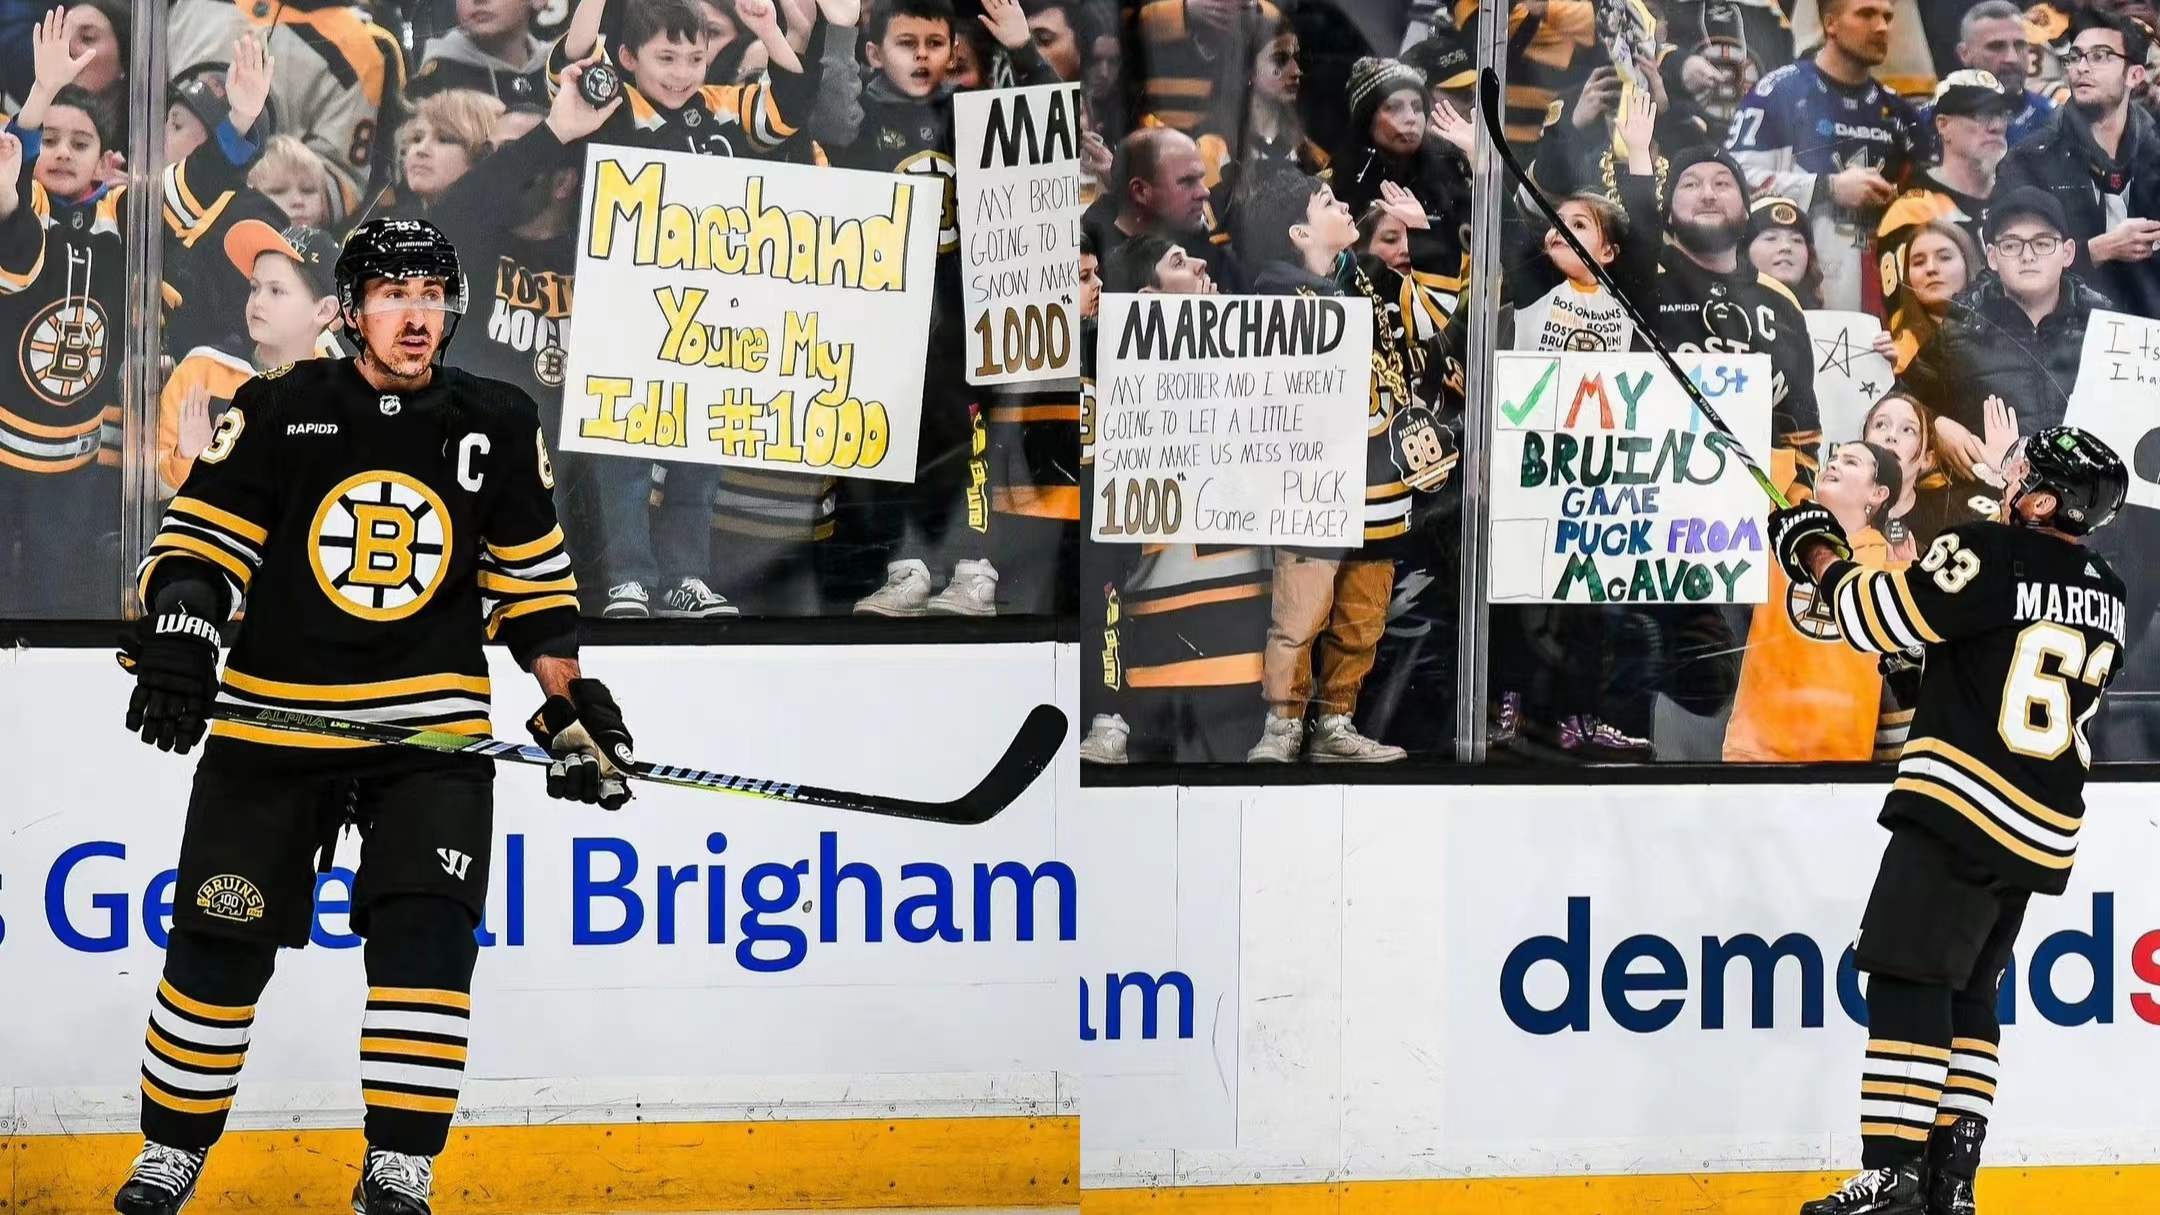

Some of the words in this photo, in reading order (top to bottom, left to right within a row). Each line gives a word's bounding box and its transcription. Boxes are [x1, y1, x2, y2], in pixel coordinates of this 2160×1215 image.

[588, 159, 914, 292] Marchand
[976, 183, 1015, 225] MY
[971, 224, 1029, 267] GOING
[1038, 223, 1056, 251] TO
[973, 268, 1029, 303] SNOW
[1040, 260, 1080, 293] MAK
[1881, 243, 1906, 297] 8
[1117, 299, 1346, 360] MARCHAND
[1756, 304, 1776, 341] C
[47, 321, 94, 381] B
[779, 310, 855, 406] My
[2110, 362, 2129, 380] I
[1110, 374, 1145, 406] MY
[1157, 371, 1219, 401] BROTHER
[1225, 372, 1255, 399] AND
[1263, 371, 1273, 396] I
[1284, 365, 1347, 395] WEREN'T
[1563, 370, 1654, 431] MY
[579, 375, 688, 448] Idol
[708, 387, 889, 469] #1000
[1103, 410, 1153, 441] GOING
[1161, 410, 1177, 436] TO
[1190, 408, 1217, 434] LET
[1228, 408, 1240, 434] A
[1250, 404, 1304, 433] LITTLE
[457, 432, 491, 493] C
[1102, 446, 1152, 472] SNOW
[1159, 443, 1200, 468] MAKE
[1211, 443, 1232, 465] US
[1240, 442, 1281, 463] MISS
[1289, 441, 1323, 462] YOUR
[1401, 426, 1443, 471] 88
[1520, 429, 1731, 488] BRUINS
[1283, 470, 1347, 504] PUCK
[1561, 486, 1660, 518] GAME
[348, 503, 416, 587] B
[1269, 509, 1348, 538] PLEASE?
[1554, 519, 1654, 556] PUCK
[1667, 517, 1763, 554] FROM
[1920, 532, 1981, 593] 63
[2014, 582, 2127, 649] MARCHAN
[257, 708, 327, 728] ALPHA
[203, 877, 260, 907] BRUINS
[220, 894, 239, 908] 100
[572, 831, 1078, 972] Brigham
